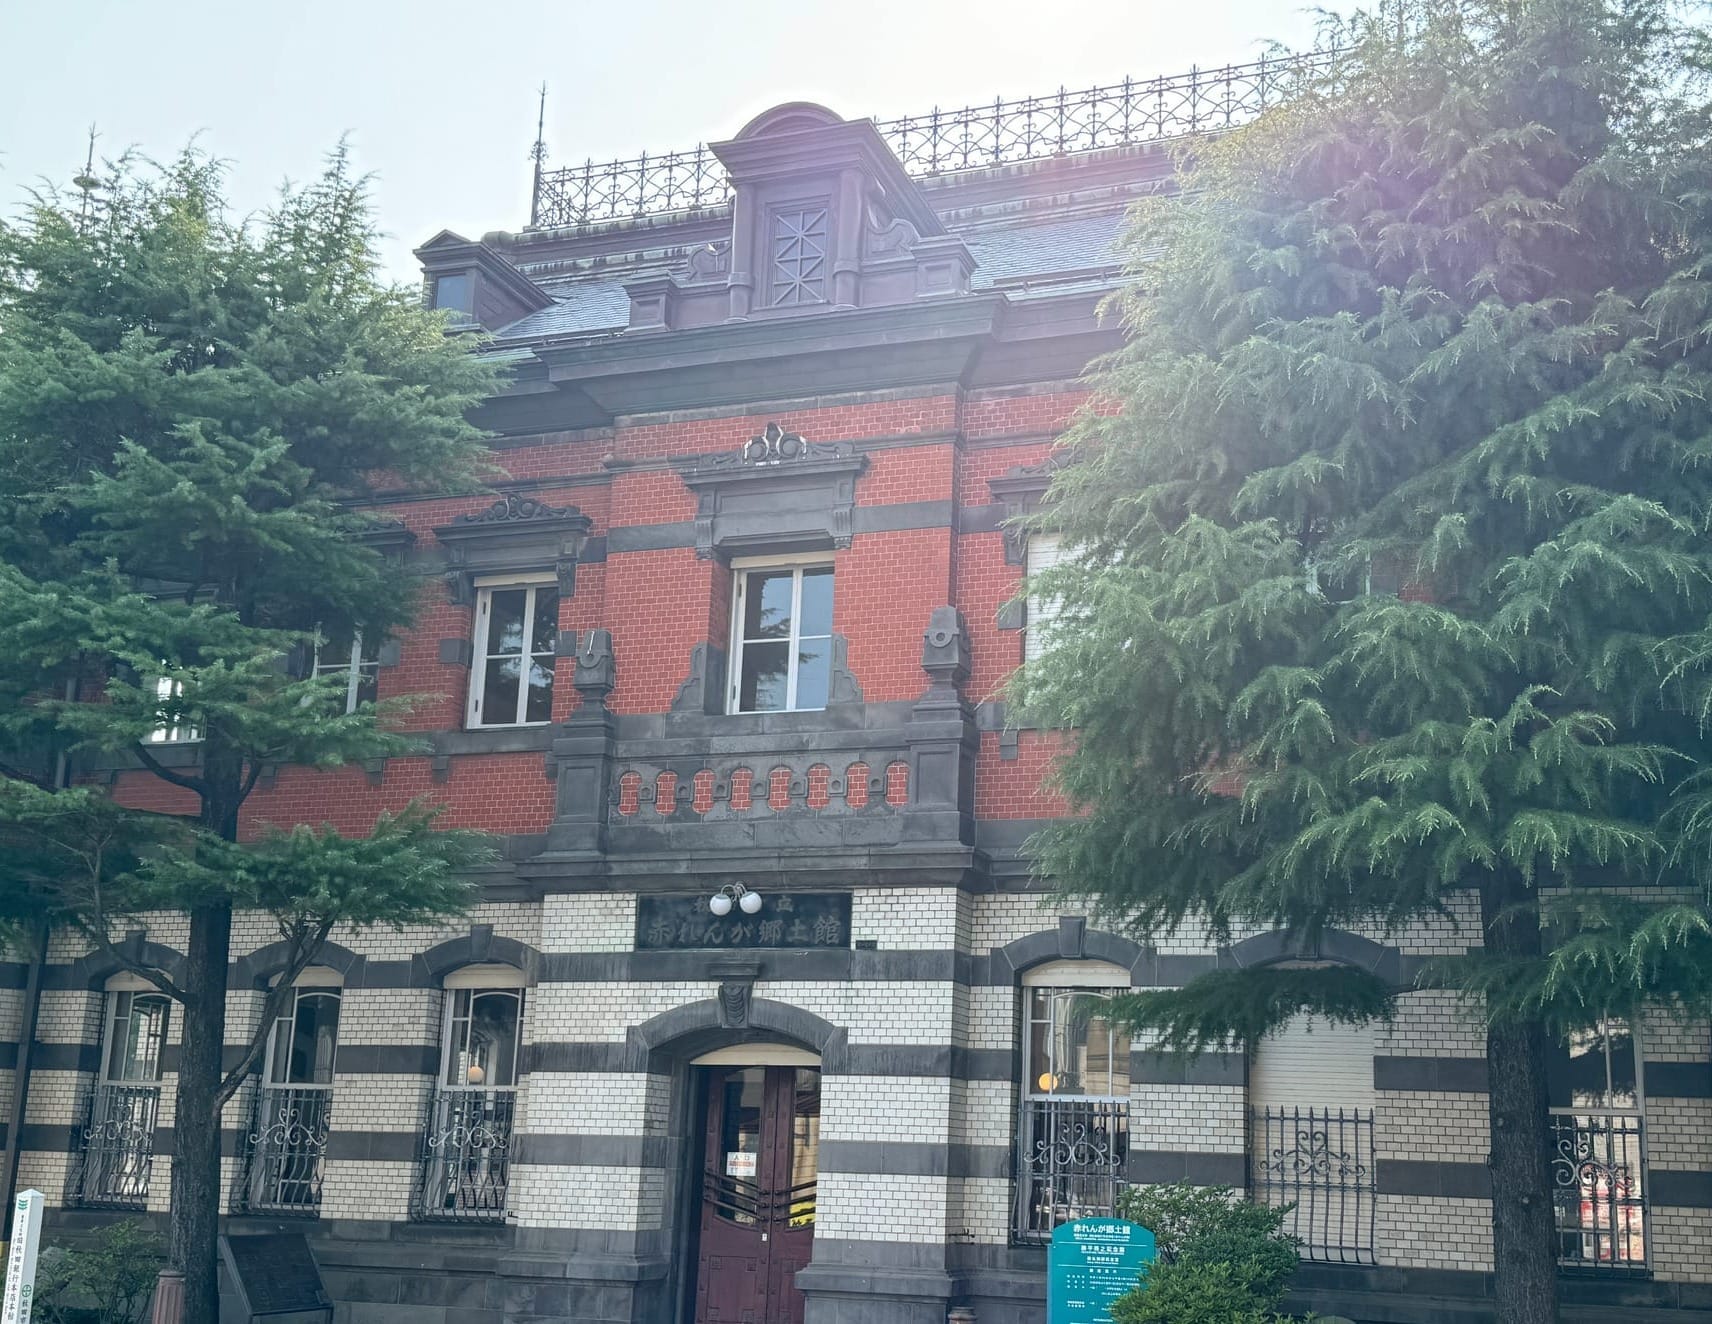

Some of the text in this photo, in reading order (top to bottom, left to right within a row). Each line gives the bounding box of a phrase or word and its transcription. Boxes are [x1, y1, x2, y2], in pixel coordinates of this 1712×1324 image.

[648, 915, 842, 946] 赤れんが郷土館
[1073, 1224, 1131, 1234] 赤れんが郷土館
